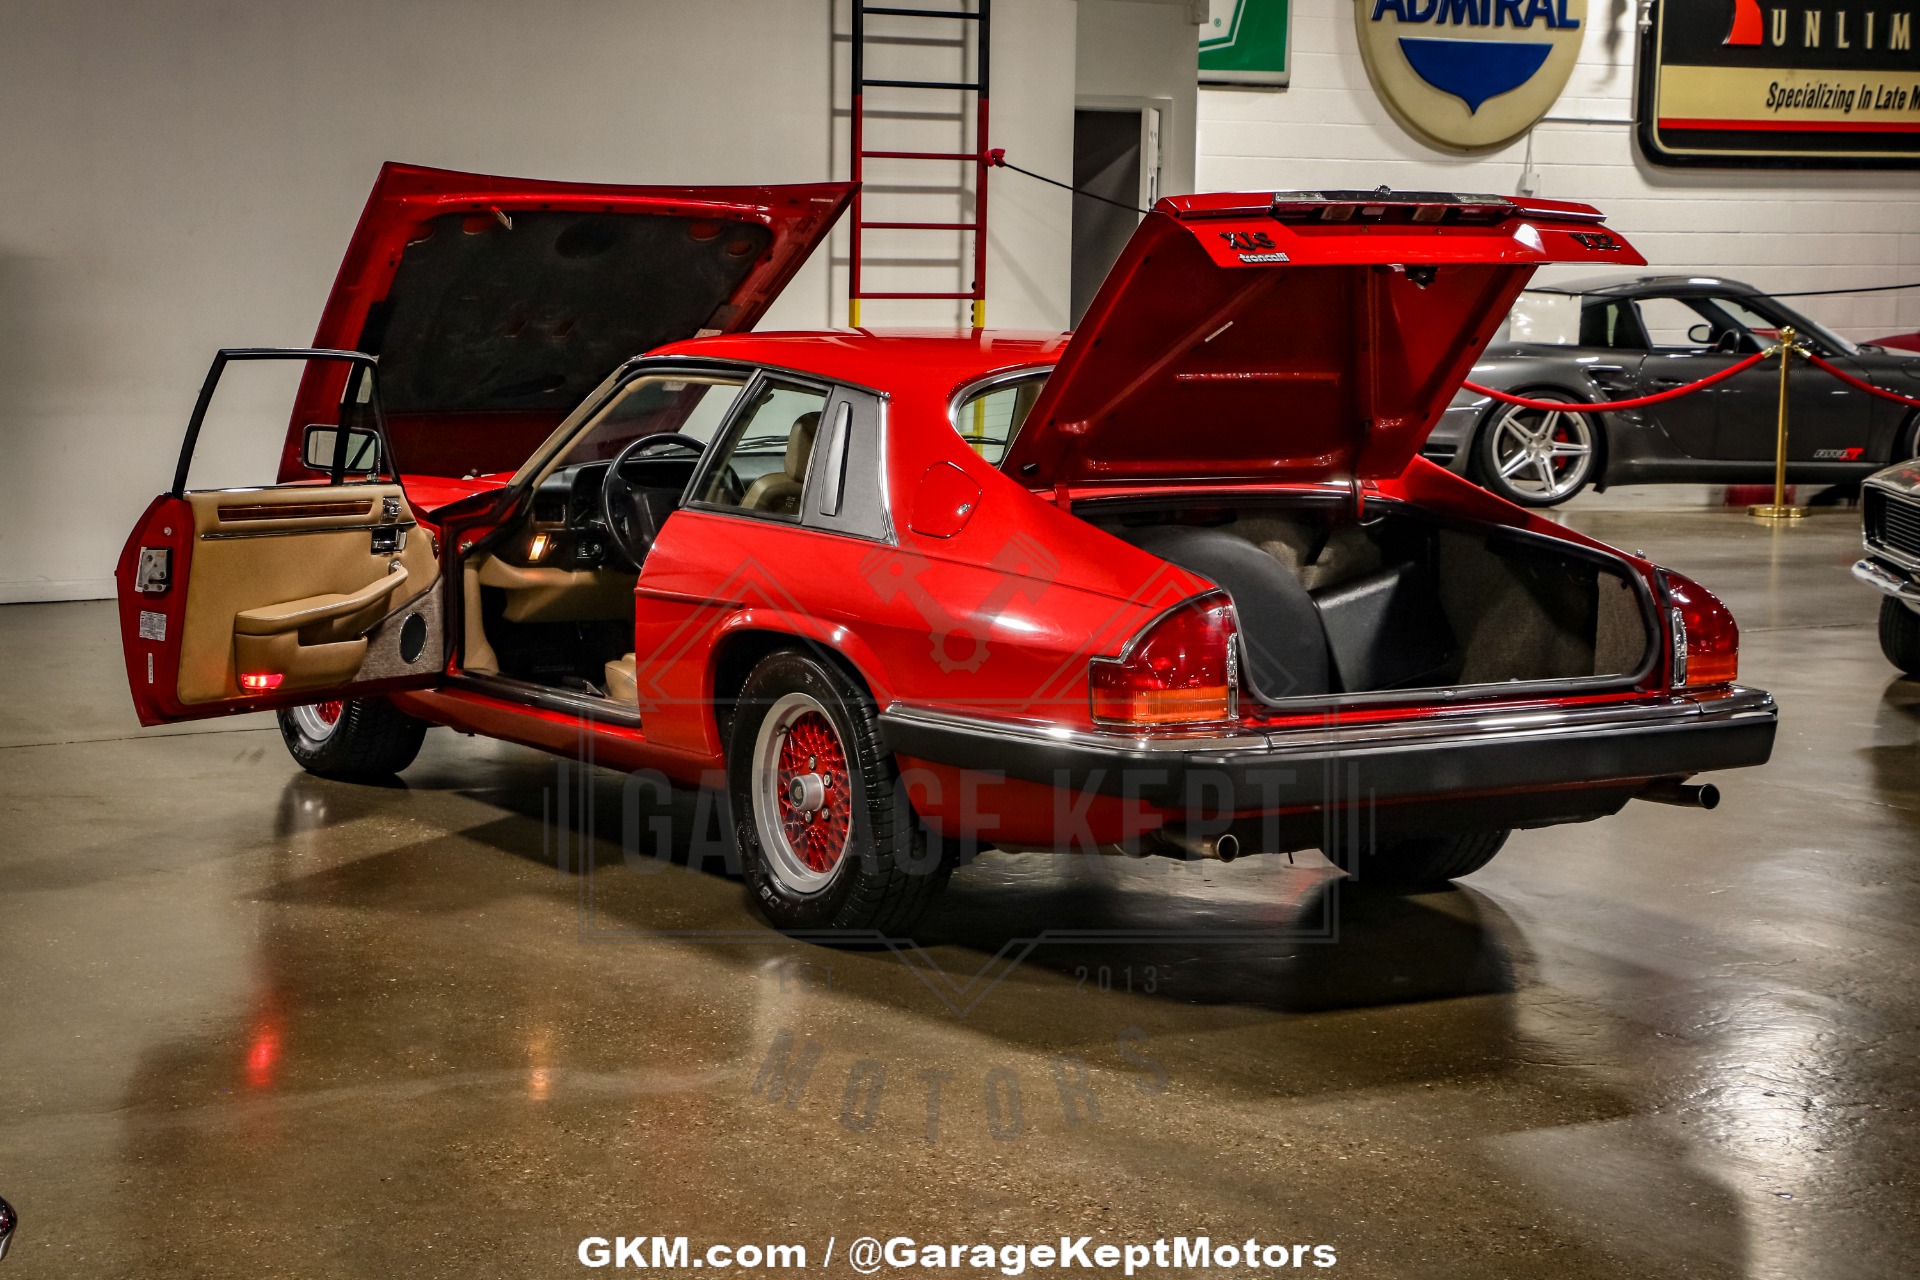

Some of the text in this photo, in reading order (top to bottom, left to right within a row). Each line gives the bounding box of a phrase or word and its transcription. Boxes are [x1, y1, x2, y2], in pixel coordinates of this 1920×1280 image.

[1766, 81, 1855, 113] Specializing
[1856, 84, 1873, 108] In
[1873, 84, 1906, 110] Late
